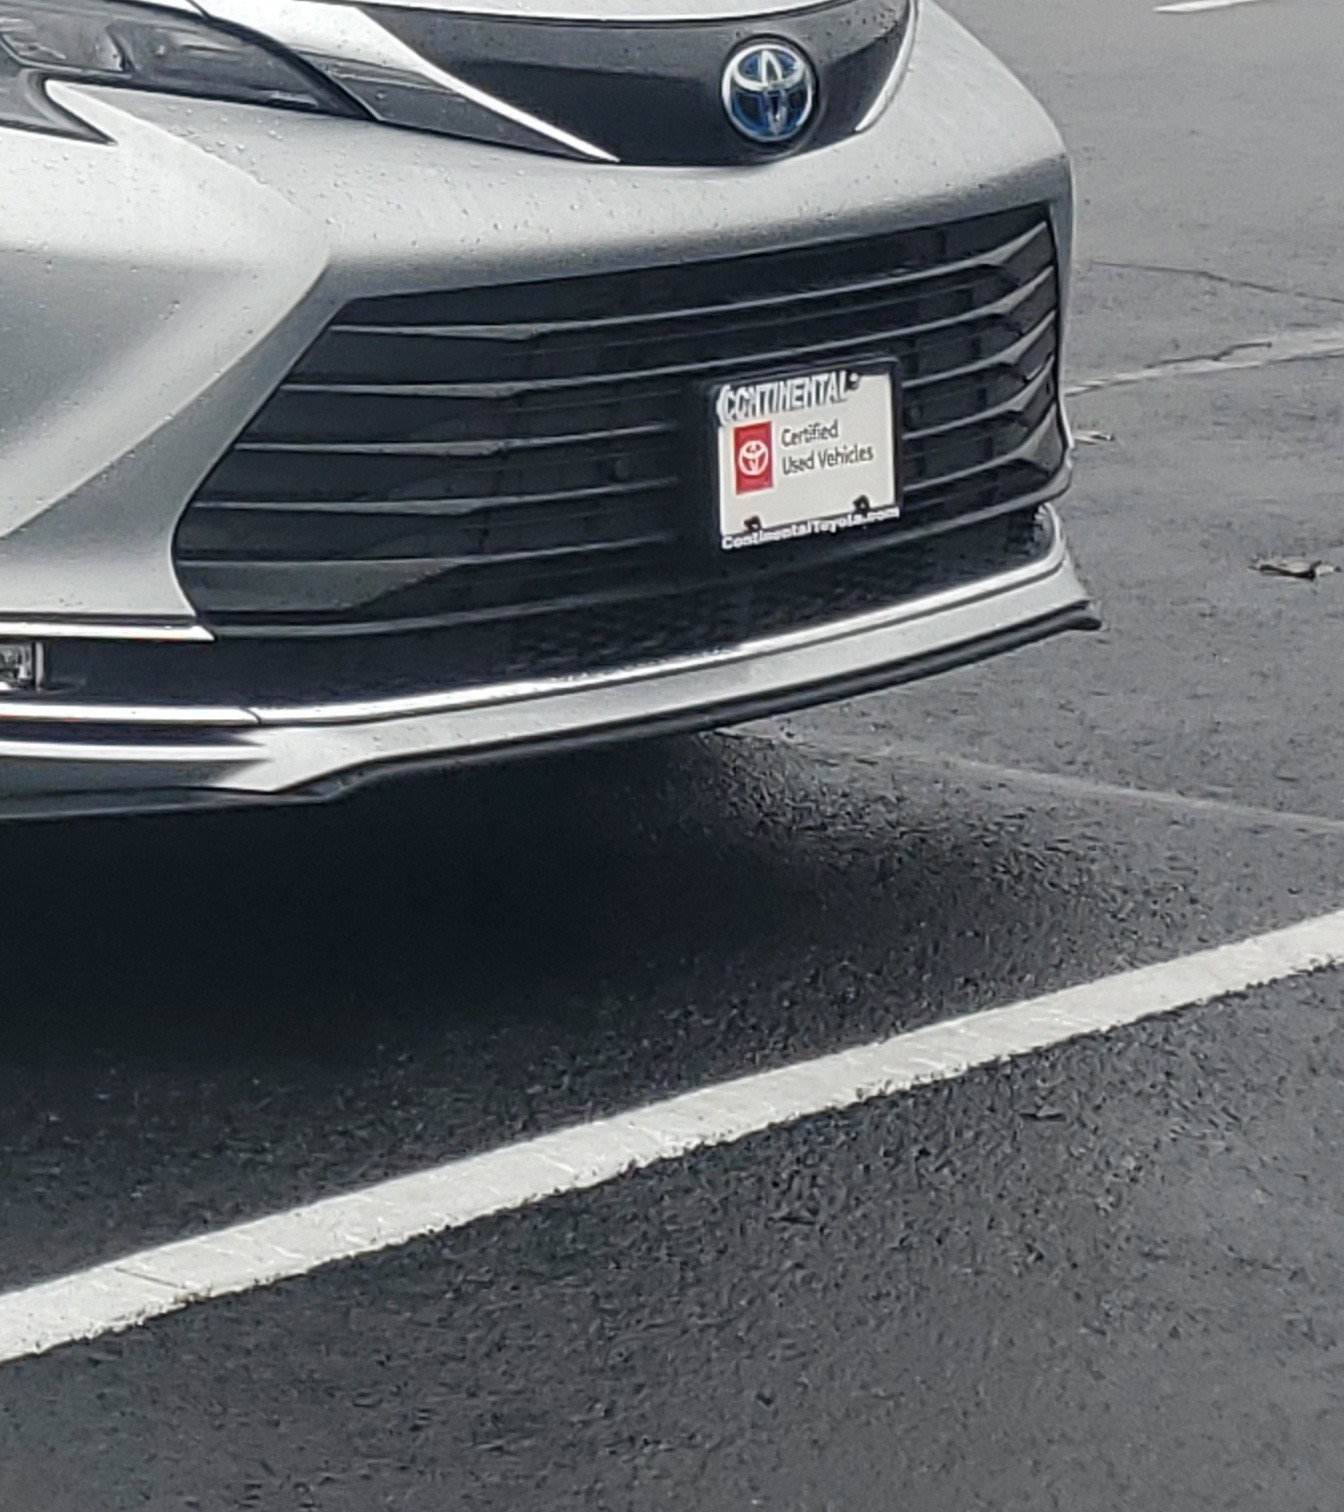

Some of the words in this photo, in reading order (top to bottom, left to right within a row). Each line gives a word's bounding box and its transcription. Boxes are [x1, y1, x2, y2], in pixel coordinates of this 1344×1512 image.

[716, 370, 849, 425] CONTINENTAL
[781, 419, 839, 448] Certified
[783, 451, 815, 475] Used
[818, 443, 874, 469] Vehicles
